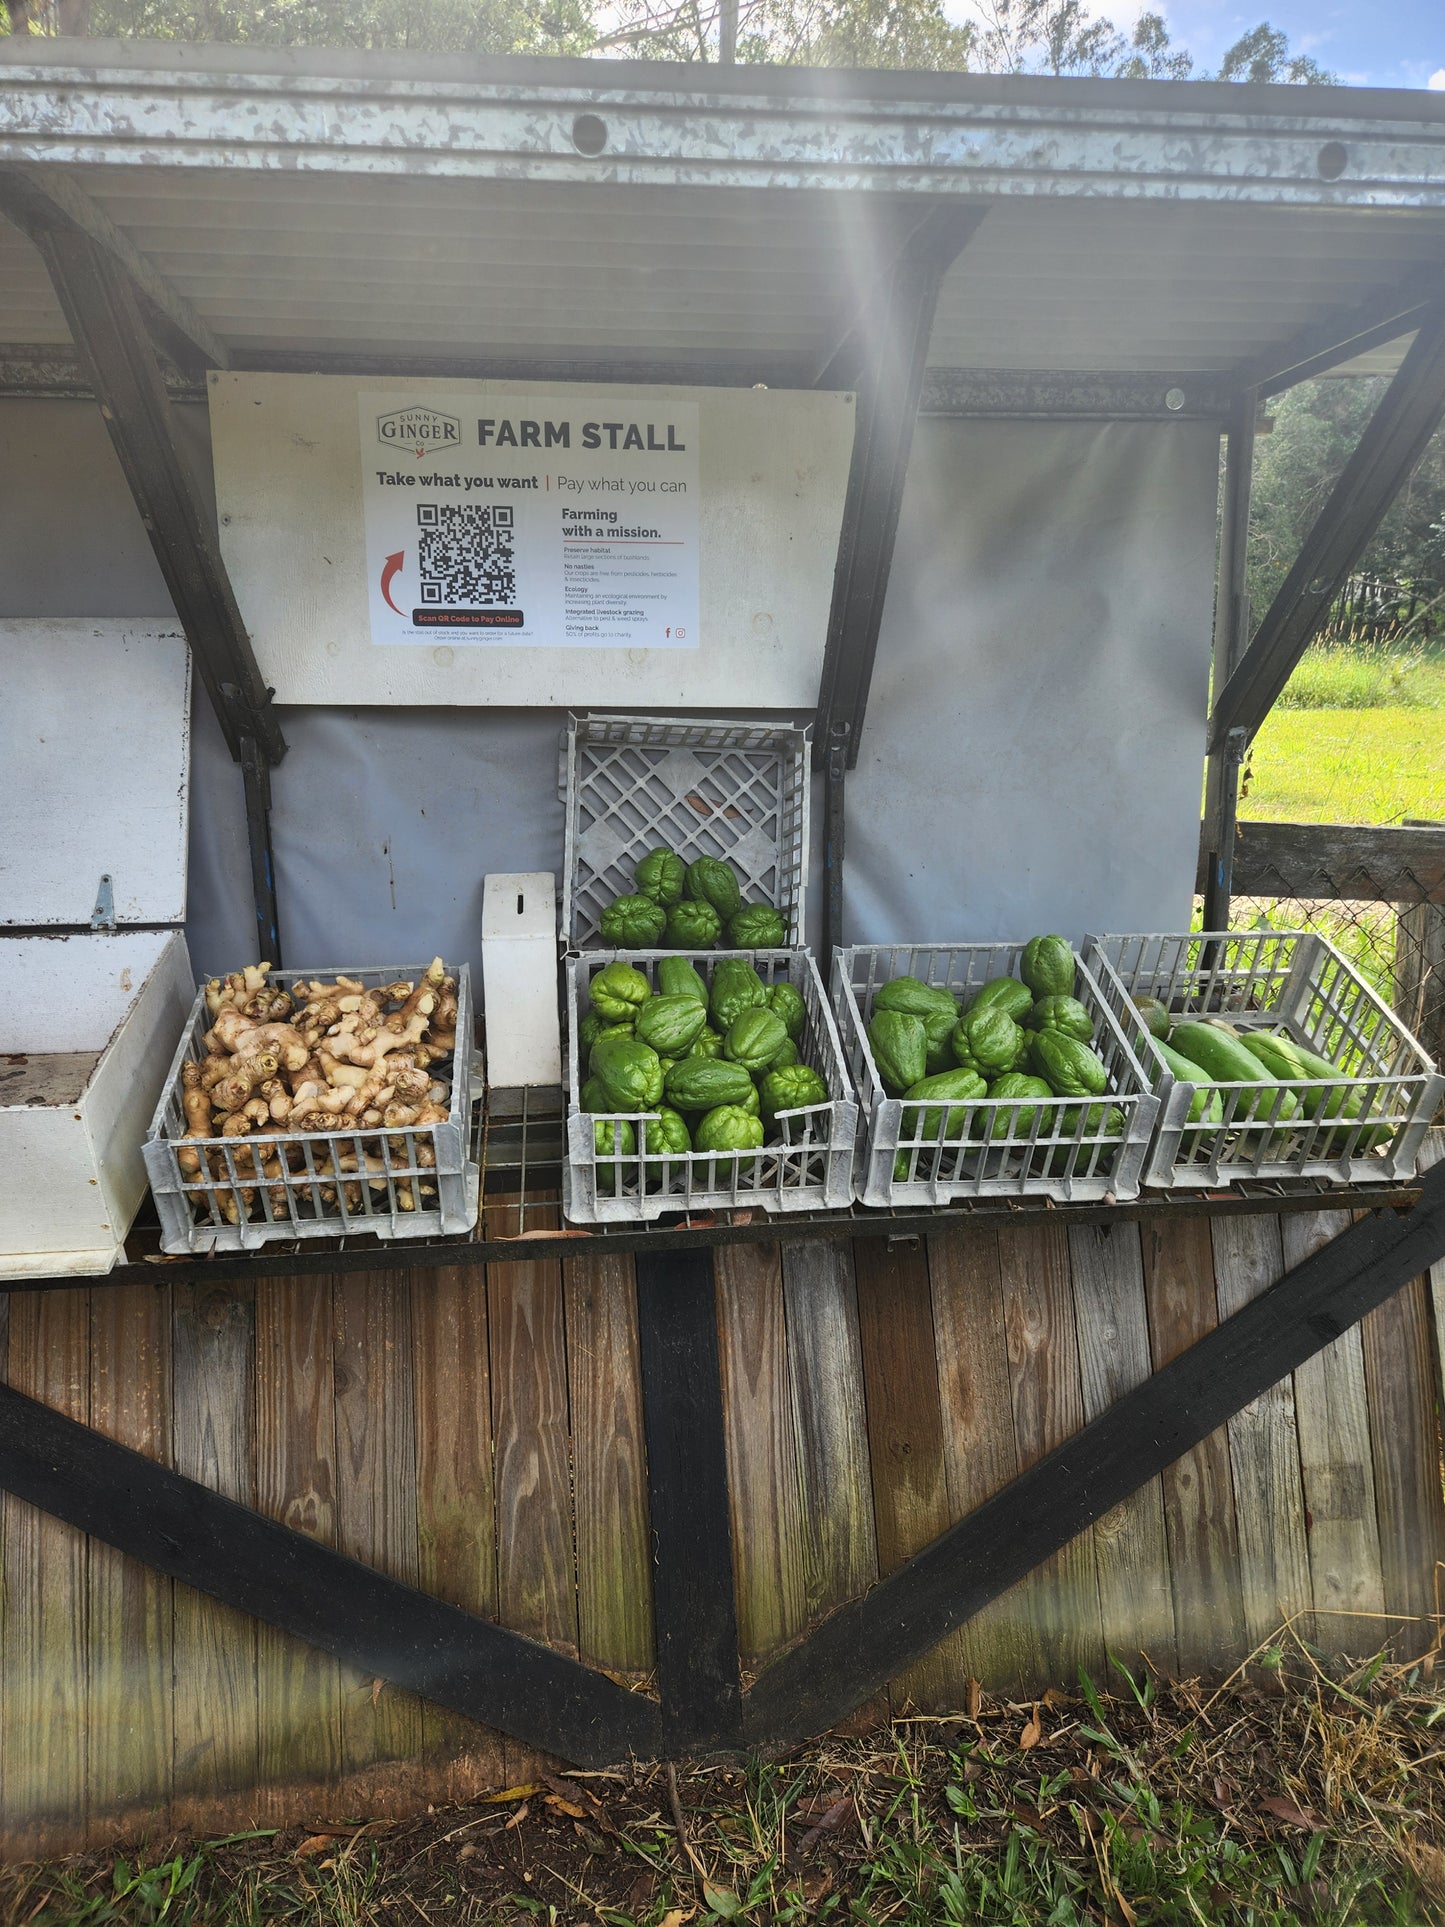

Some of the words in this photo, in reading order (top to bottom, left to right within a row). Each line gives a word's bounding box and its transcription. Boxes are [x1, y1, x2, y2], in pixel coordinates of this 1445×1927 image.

[400, 414, 438, 422] SUNNY
[382, 421, 458, 440] GINGER
[478, 419, 570, 448] FARM
[582, 422, 686, 451] STALL
[376, 472, 416, 486] Take
[419, 473, 461, 486] what
[464, 477, 494, 491] you
[497, 476, 538, 489] want
[558, 476, 585, 493] Pay
[588, 477, 625, 492] what
[628, 480, 656, 494] you
[660, 480, 686, 492] can
[562, 508, 618, 523] Farming
[562, 525, 592, 536] with
[596, 528, 604, 537] a
[607, 526, 661, 538] mission.
[481, 616, 493, 624] Pay
